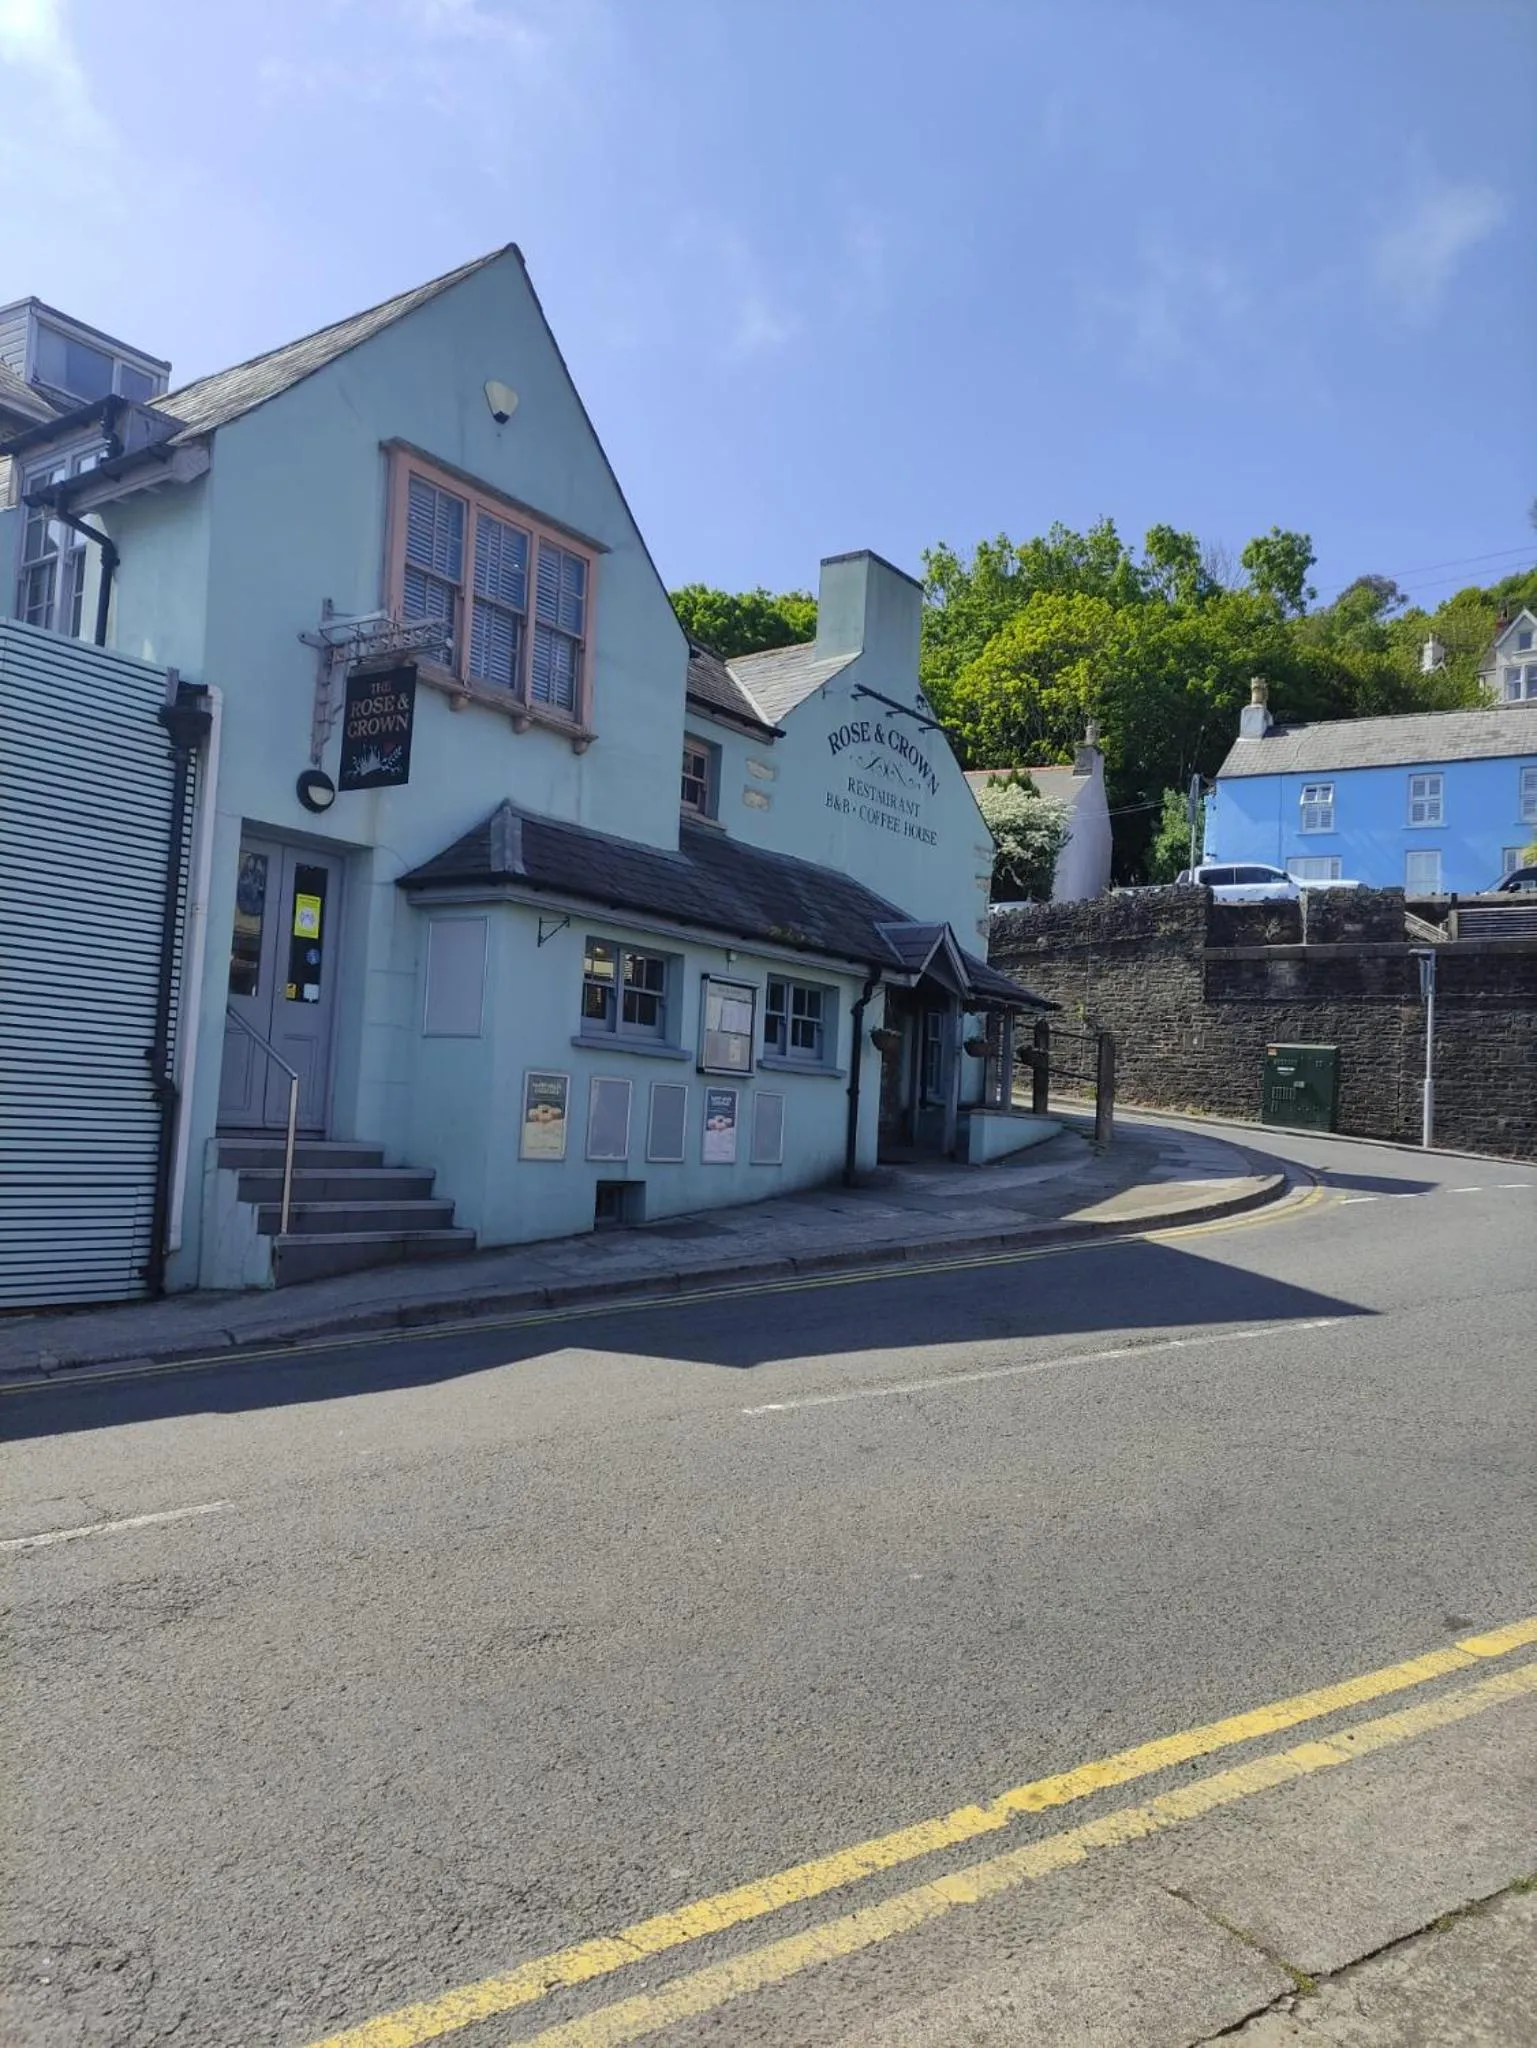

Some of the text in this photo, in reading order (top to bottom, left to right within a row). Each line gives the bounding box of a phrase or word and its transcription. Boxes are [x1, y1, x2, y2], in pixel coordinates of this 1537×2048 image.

[350, 692, 409, 718] ROSE &
[371, 682, 392, 694] THE
[347, 713, 409, 738] CROWN
[828, 721, 940, 796] ROSE & CROWN
[847, 776, 921, 818] RESTAURANT
[825, 791, 938, 846] B&B COFFEE HOUSE
